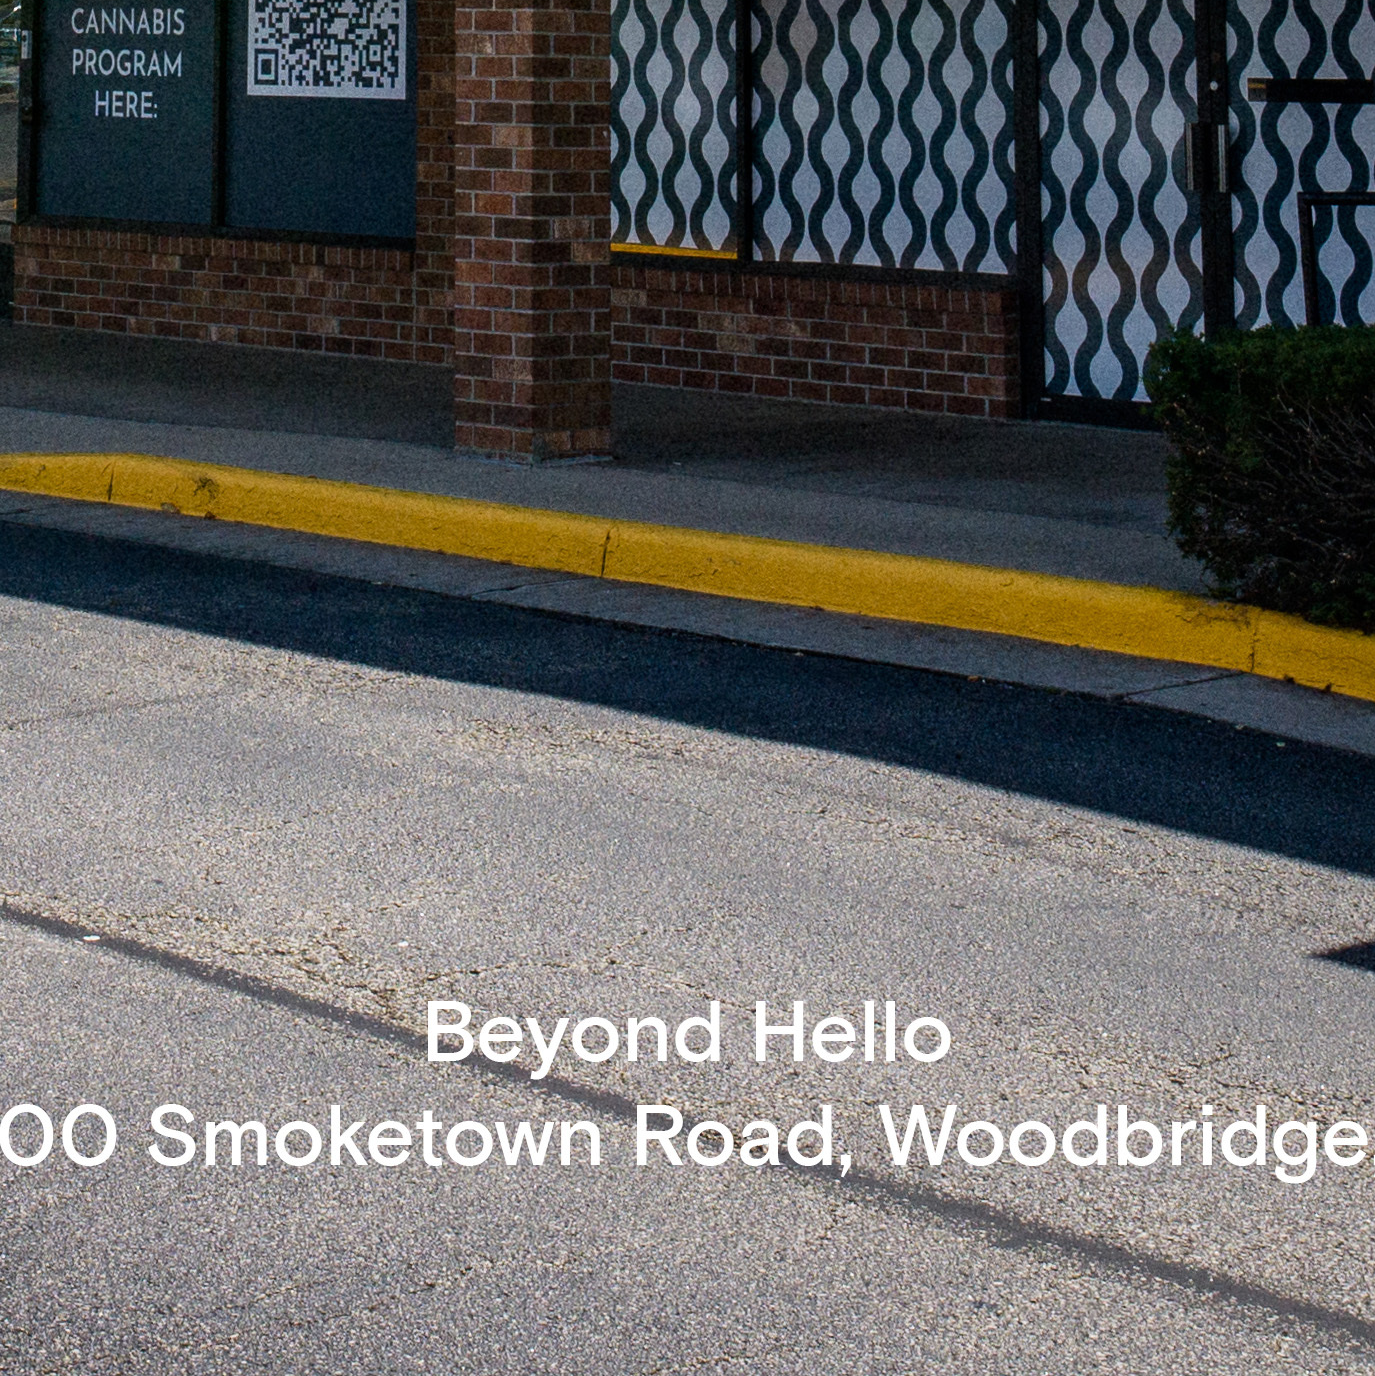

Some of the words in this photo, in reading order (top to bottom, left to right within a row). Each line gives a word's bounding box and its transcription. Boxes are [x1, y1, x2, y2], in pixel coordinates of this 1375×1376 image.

[71, 8, 184, 35] CANNABIS
[72, 49, 181, 77] PROGRAM
[94, 91, 158, 118] HERE:
